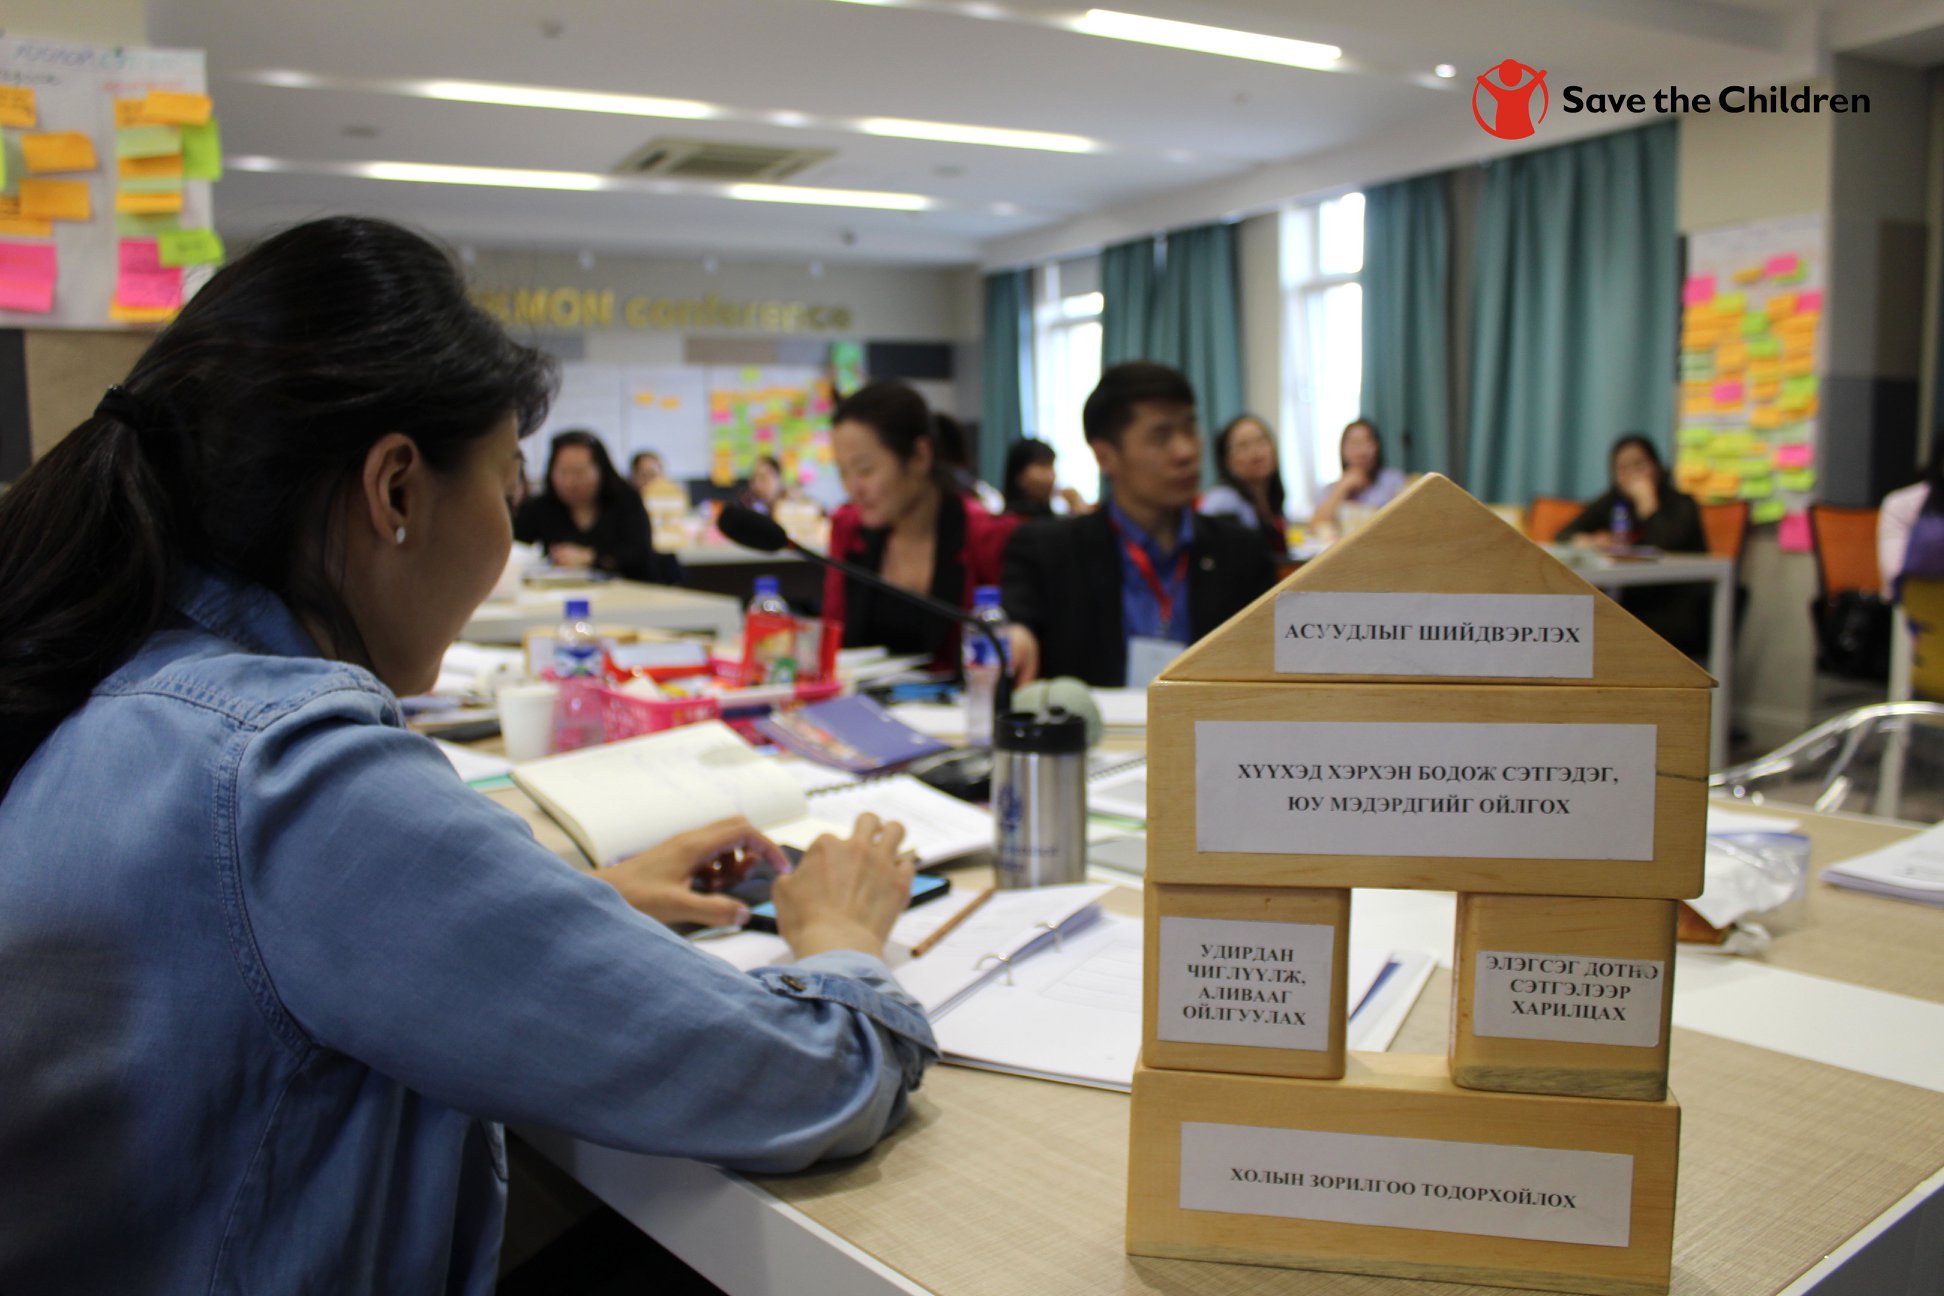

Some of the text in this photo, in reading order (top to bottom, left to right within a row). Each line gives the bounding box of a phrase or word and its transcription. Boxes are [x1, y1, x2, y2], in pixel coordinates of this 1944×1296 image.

[625, 291, 853, 331] conference
[1284, 622, 1580, 644] АСУУДЛЫГ ШИЙДВЭРЛЭХ
[1237, 763, 1619, 784] ХҮҮХЭД ХЭРХЭН БОДОЖ СЭТГЭДЭГ,
[1287, 795, 1571, 815] ЮУ МЭДЭРДГИЙГ ОЙЛГОХ
[1200, 944, 1294, 963] УДИРДАН
[1486, 955, 1658, 980] ЭЛЭГСЭГ ДОТНО
[1198, 986, 1293, 1005] АЛИВААГ
[1510, 978, 1631, 999] СЭТГЭЛЭЭР
[1182, 1003, 1306, 1026] ОЙЛГУУЛАХ
[1511, 1000, 1626, 1022] ХАРИЛЦАХ
[1230, 1167, 1577, 1209] ХОЛЫН ЗОРИЛГОО ТОДОРХОЙЛОХ
